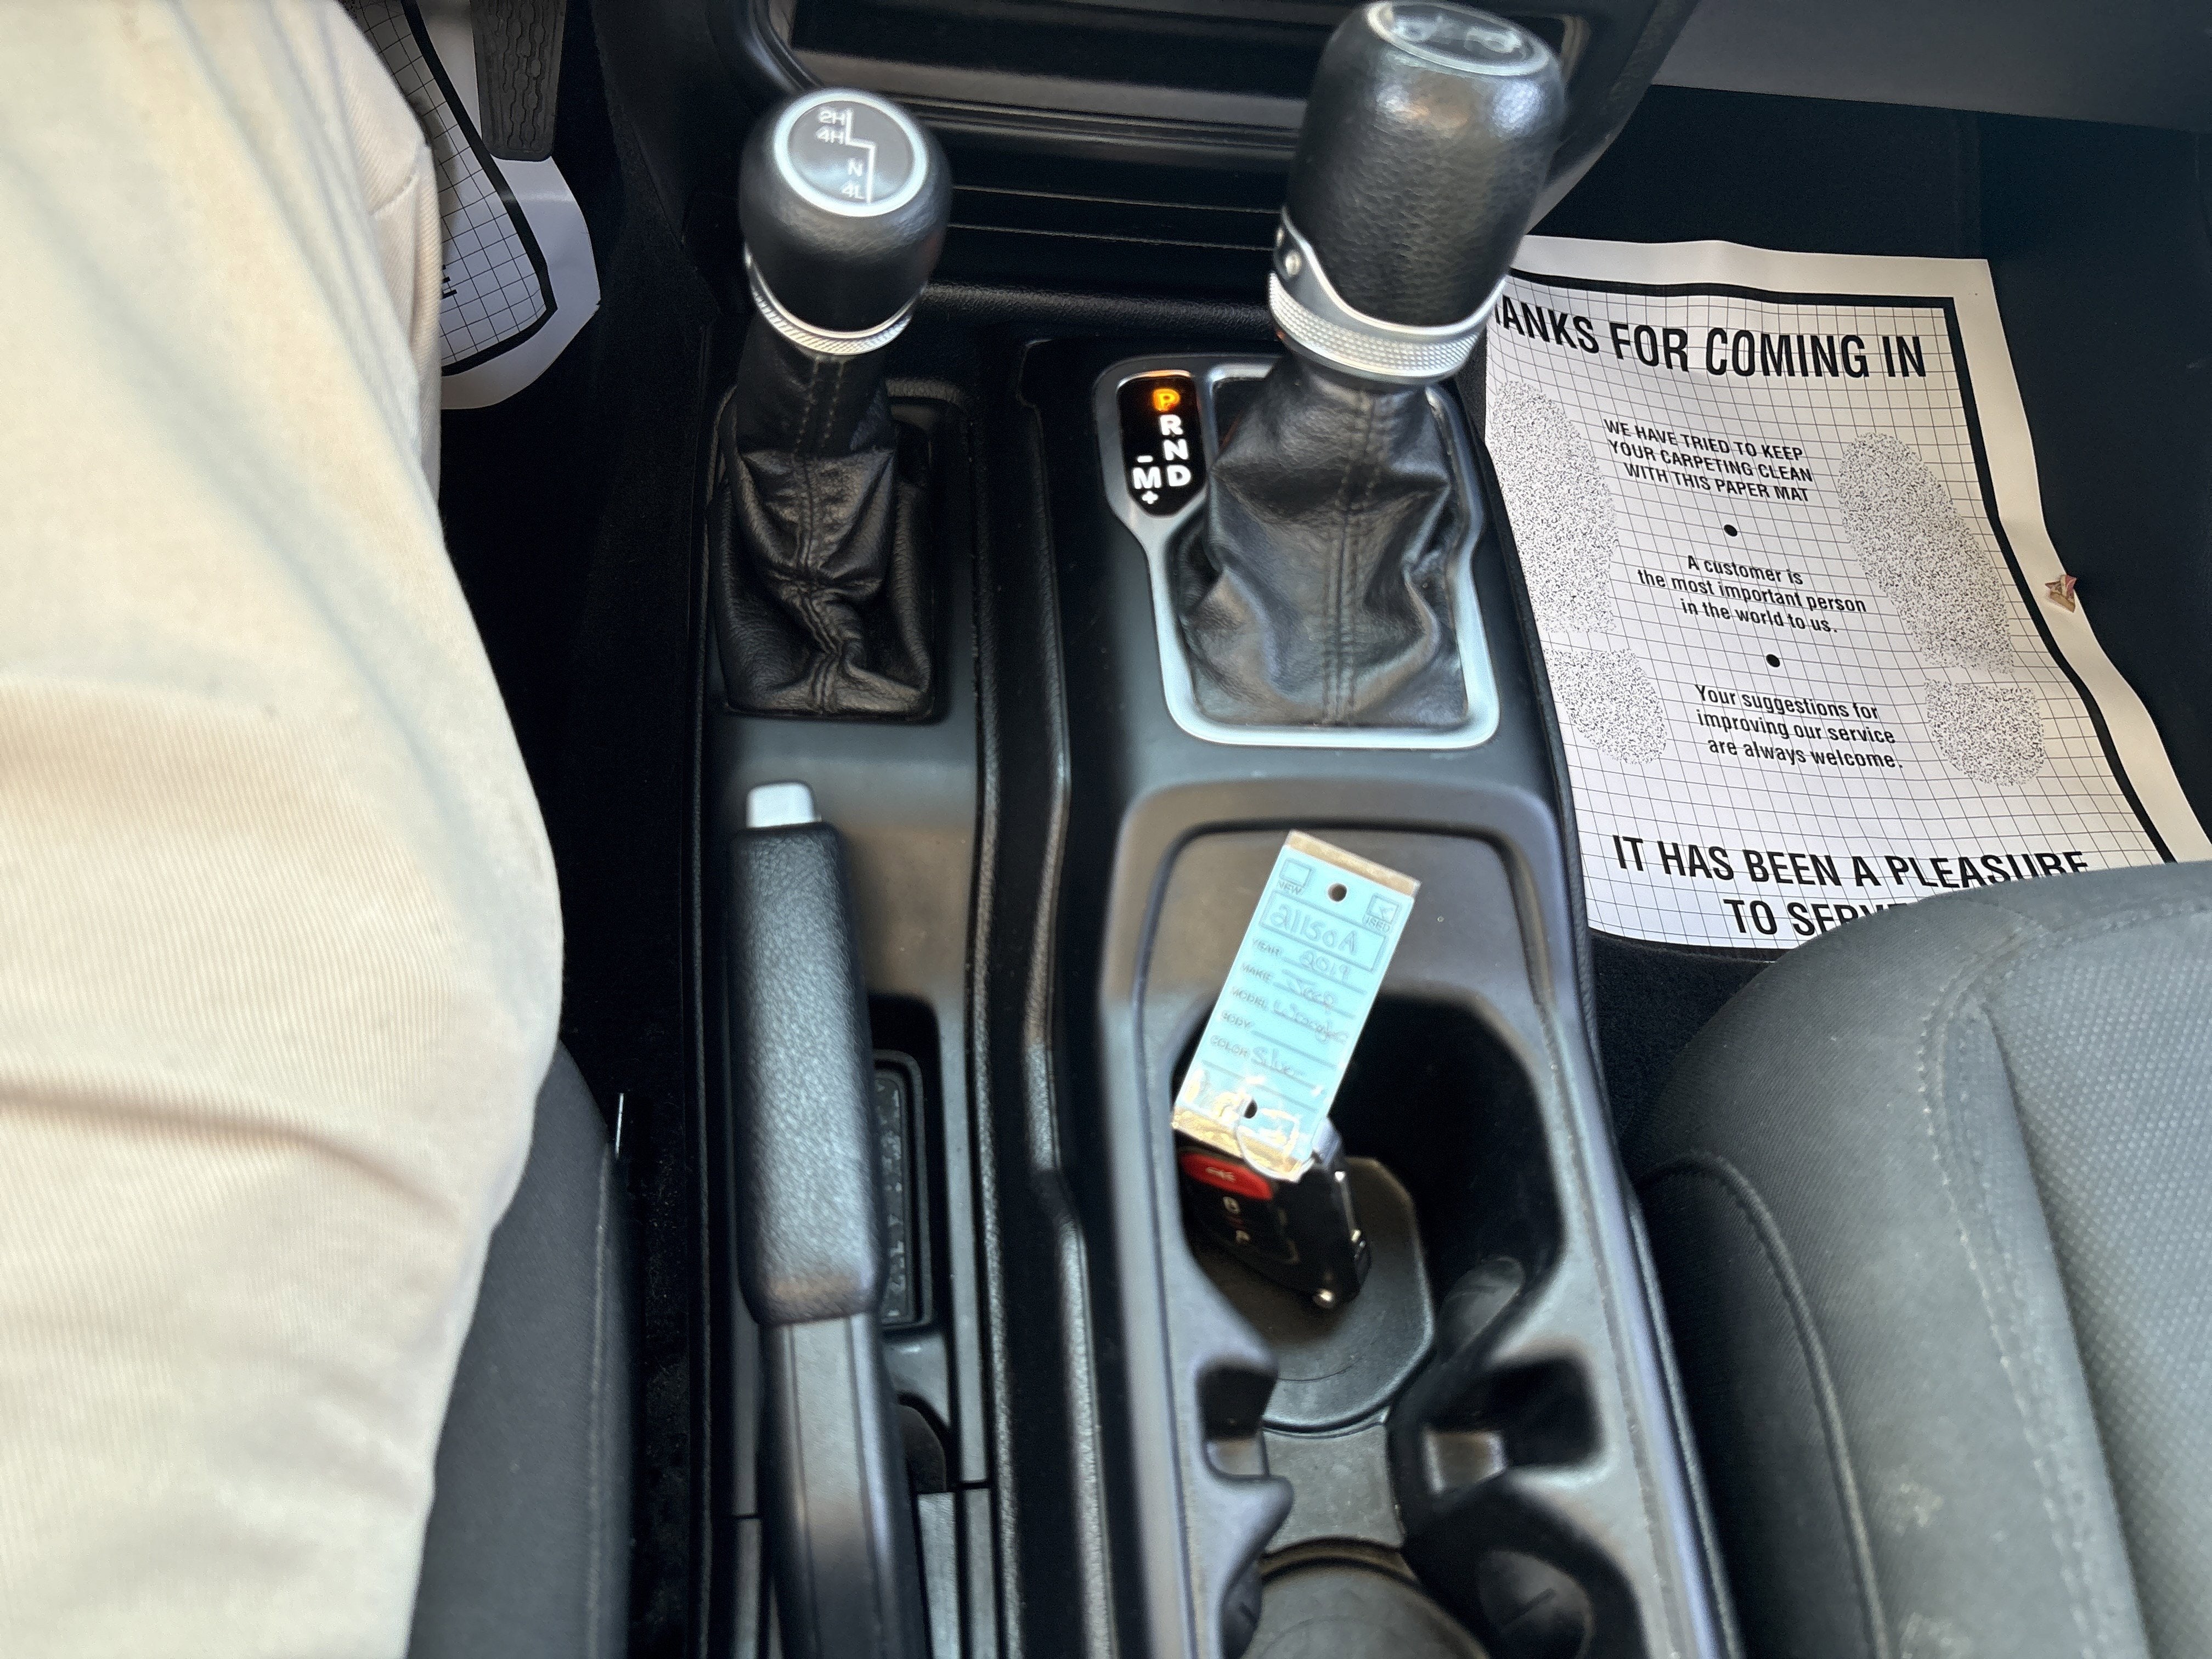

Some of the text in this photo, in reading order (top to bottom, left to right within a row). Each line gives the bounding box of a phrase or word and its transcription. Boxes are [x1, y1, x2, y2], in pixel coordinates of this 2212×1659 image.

[817, 107, 846, 125] 2H
[816, 127, 845, 144] 4H
[848, 158, 864, 177] N
[842, 181, 865, 200] 4L
[1495, 295, 1927, 378] ANKS FOR COMING IN
[1153, 388, 1180, 411] P
[1159, 414, 1183, 435] R
[1603, 419, 1803, 461] WE HAVE TRIED TO KEEP
[1163, 438, 1189, 460] N
[1607, 439, 1813, 482] YOUR CARPETING CLEAN
[1132, 465, 1191, 489] M D
[1623, 462, 1810, 502] WITH THIS PAPER MAT
[1688, 555, 1803, 585] A customer is
[1638, 569, 1867, 613] the most important person
[1680, 598, 1837, 634] in the world to us.
[1694, 684, 1879, 720] Your suggestions for
[1696, 709, 1895, 744] improving our service
[1708, 738, 1903, 769] are always welcome.
[1612, 834, 2089, 888] IT HAS BEEN A PLEASURE
[1723, 898, 1908, 936] TO SER
